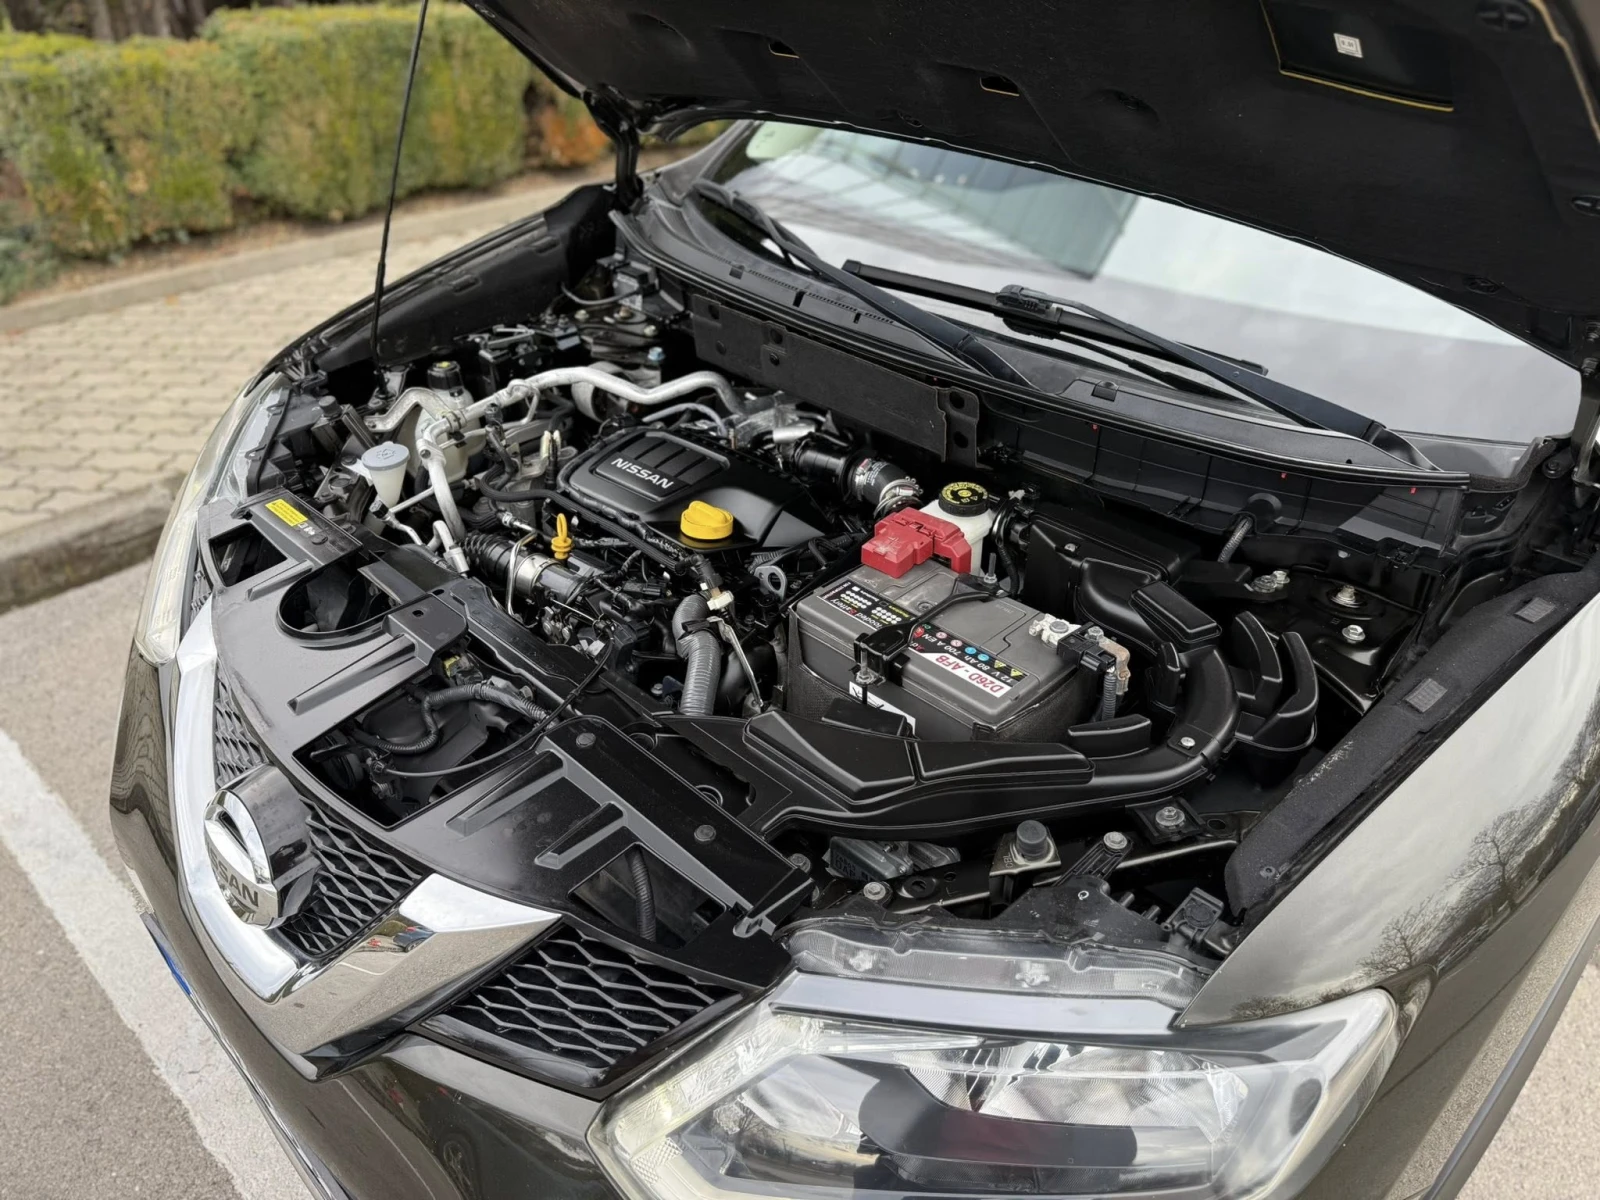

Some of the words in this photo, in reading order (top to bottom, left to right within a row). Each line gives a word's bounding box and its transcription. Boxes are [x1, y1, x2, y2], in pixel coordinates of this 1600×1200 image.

[611, 458, 674, 489] NISSAN
[829, 598, 859, 614] Battery
[855, 613, 884, 628] looded
[922, 632, 936, 643] EN
[943, 644, 961, 656] 700
[936, 654, 964, 672] AFB
[963, 654, 978, 665] Ah
[977, 662, 990, 671] 80
[991, 669, 1001, 677] V
[968, 671, 1004, 693] D26D
[1000, 675, 1013, 683] 12
[206, 840, 258, 906] ISSAN
